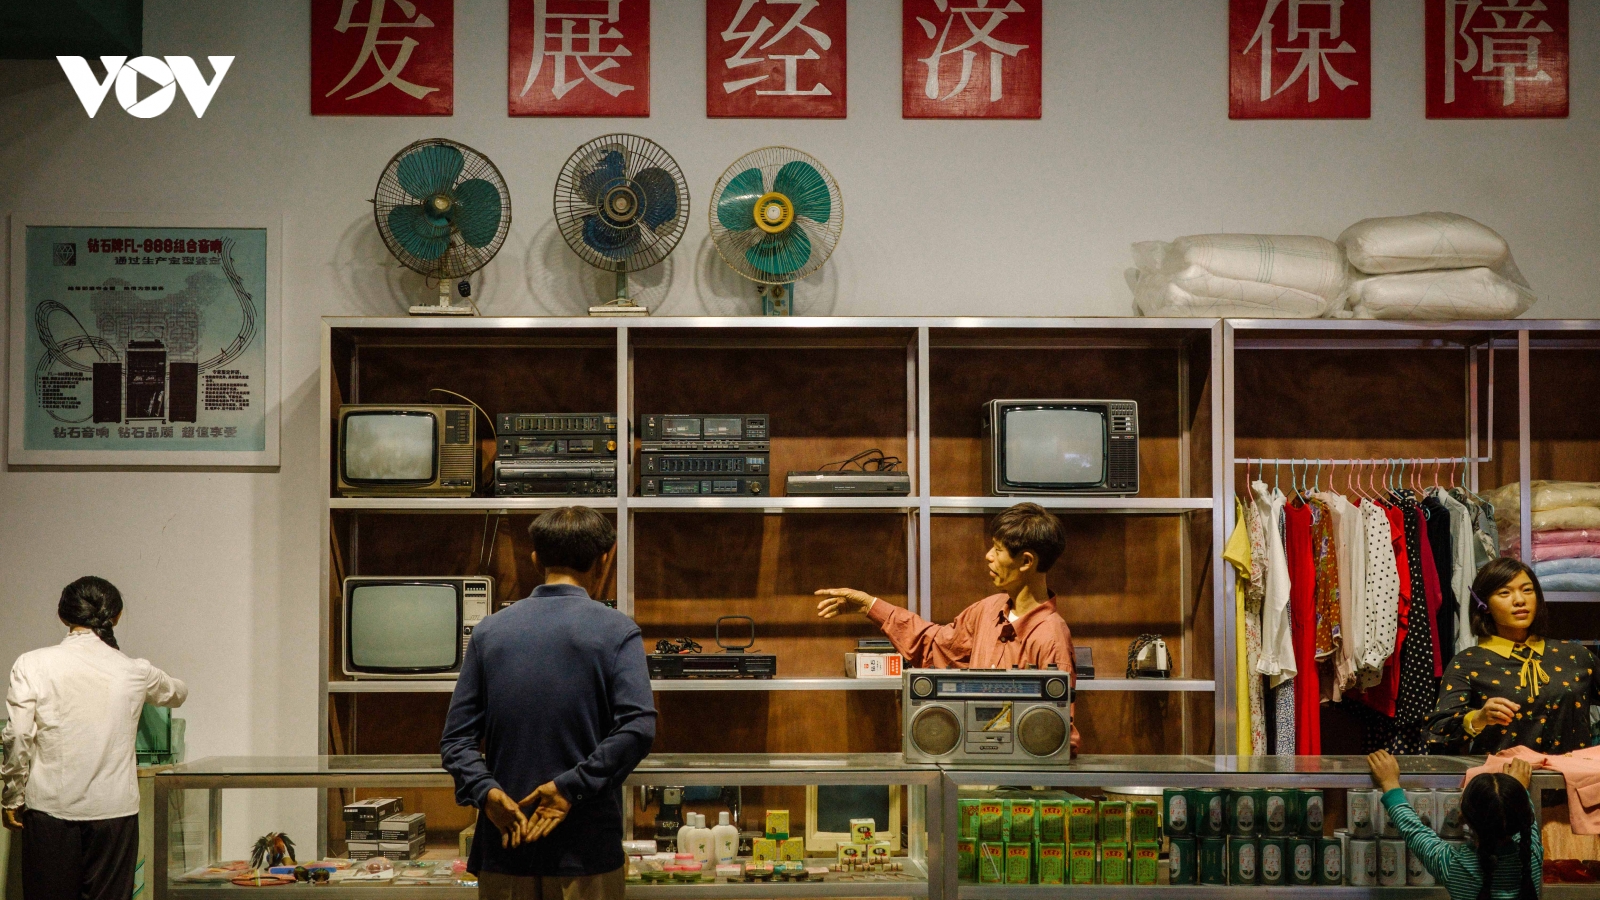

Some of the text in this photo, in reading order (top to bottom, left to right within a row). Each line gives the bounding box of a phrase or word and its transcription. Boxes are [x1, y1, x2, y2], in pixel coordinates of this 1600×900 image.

[1243, 0, 1555, 105] 保障
[53, 426, 238, 439] 钻石音响 钻石品质 超值享受
